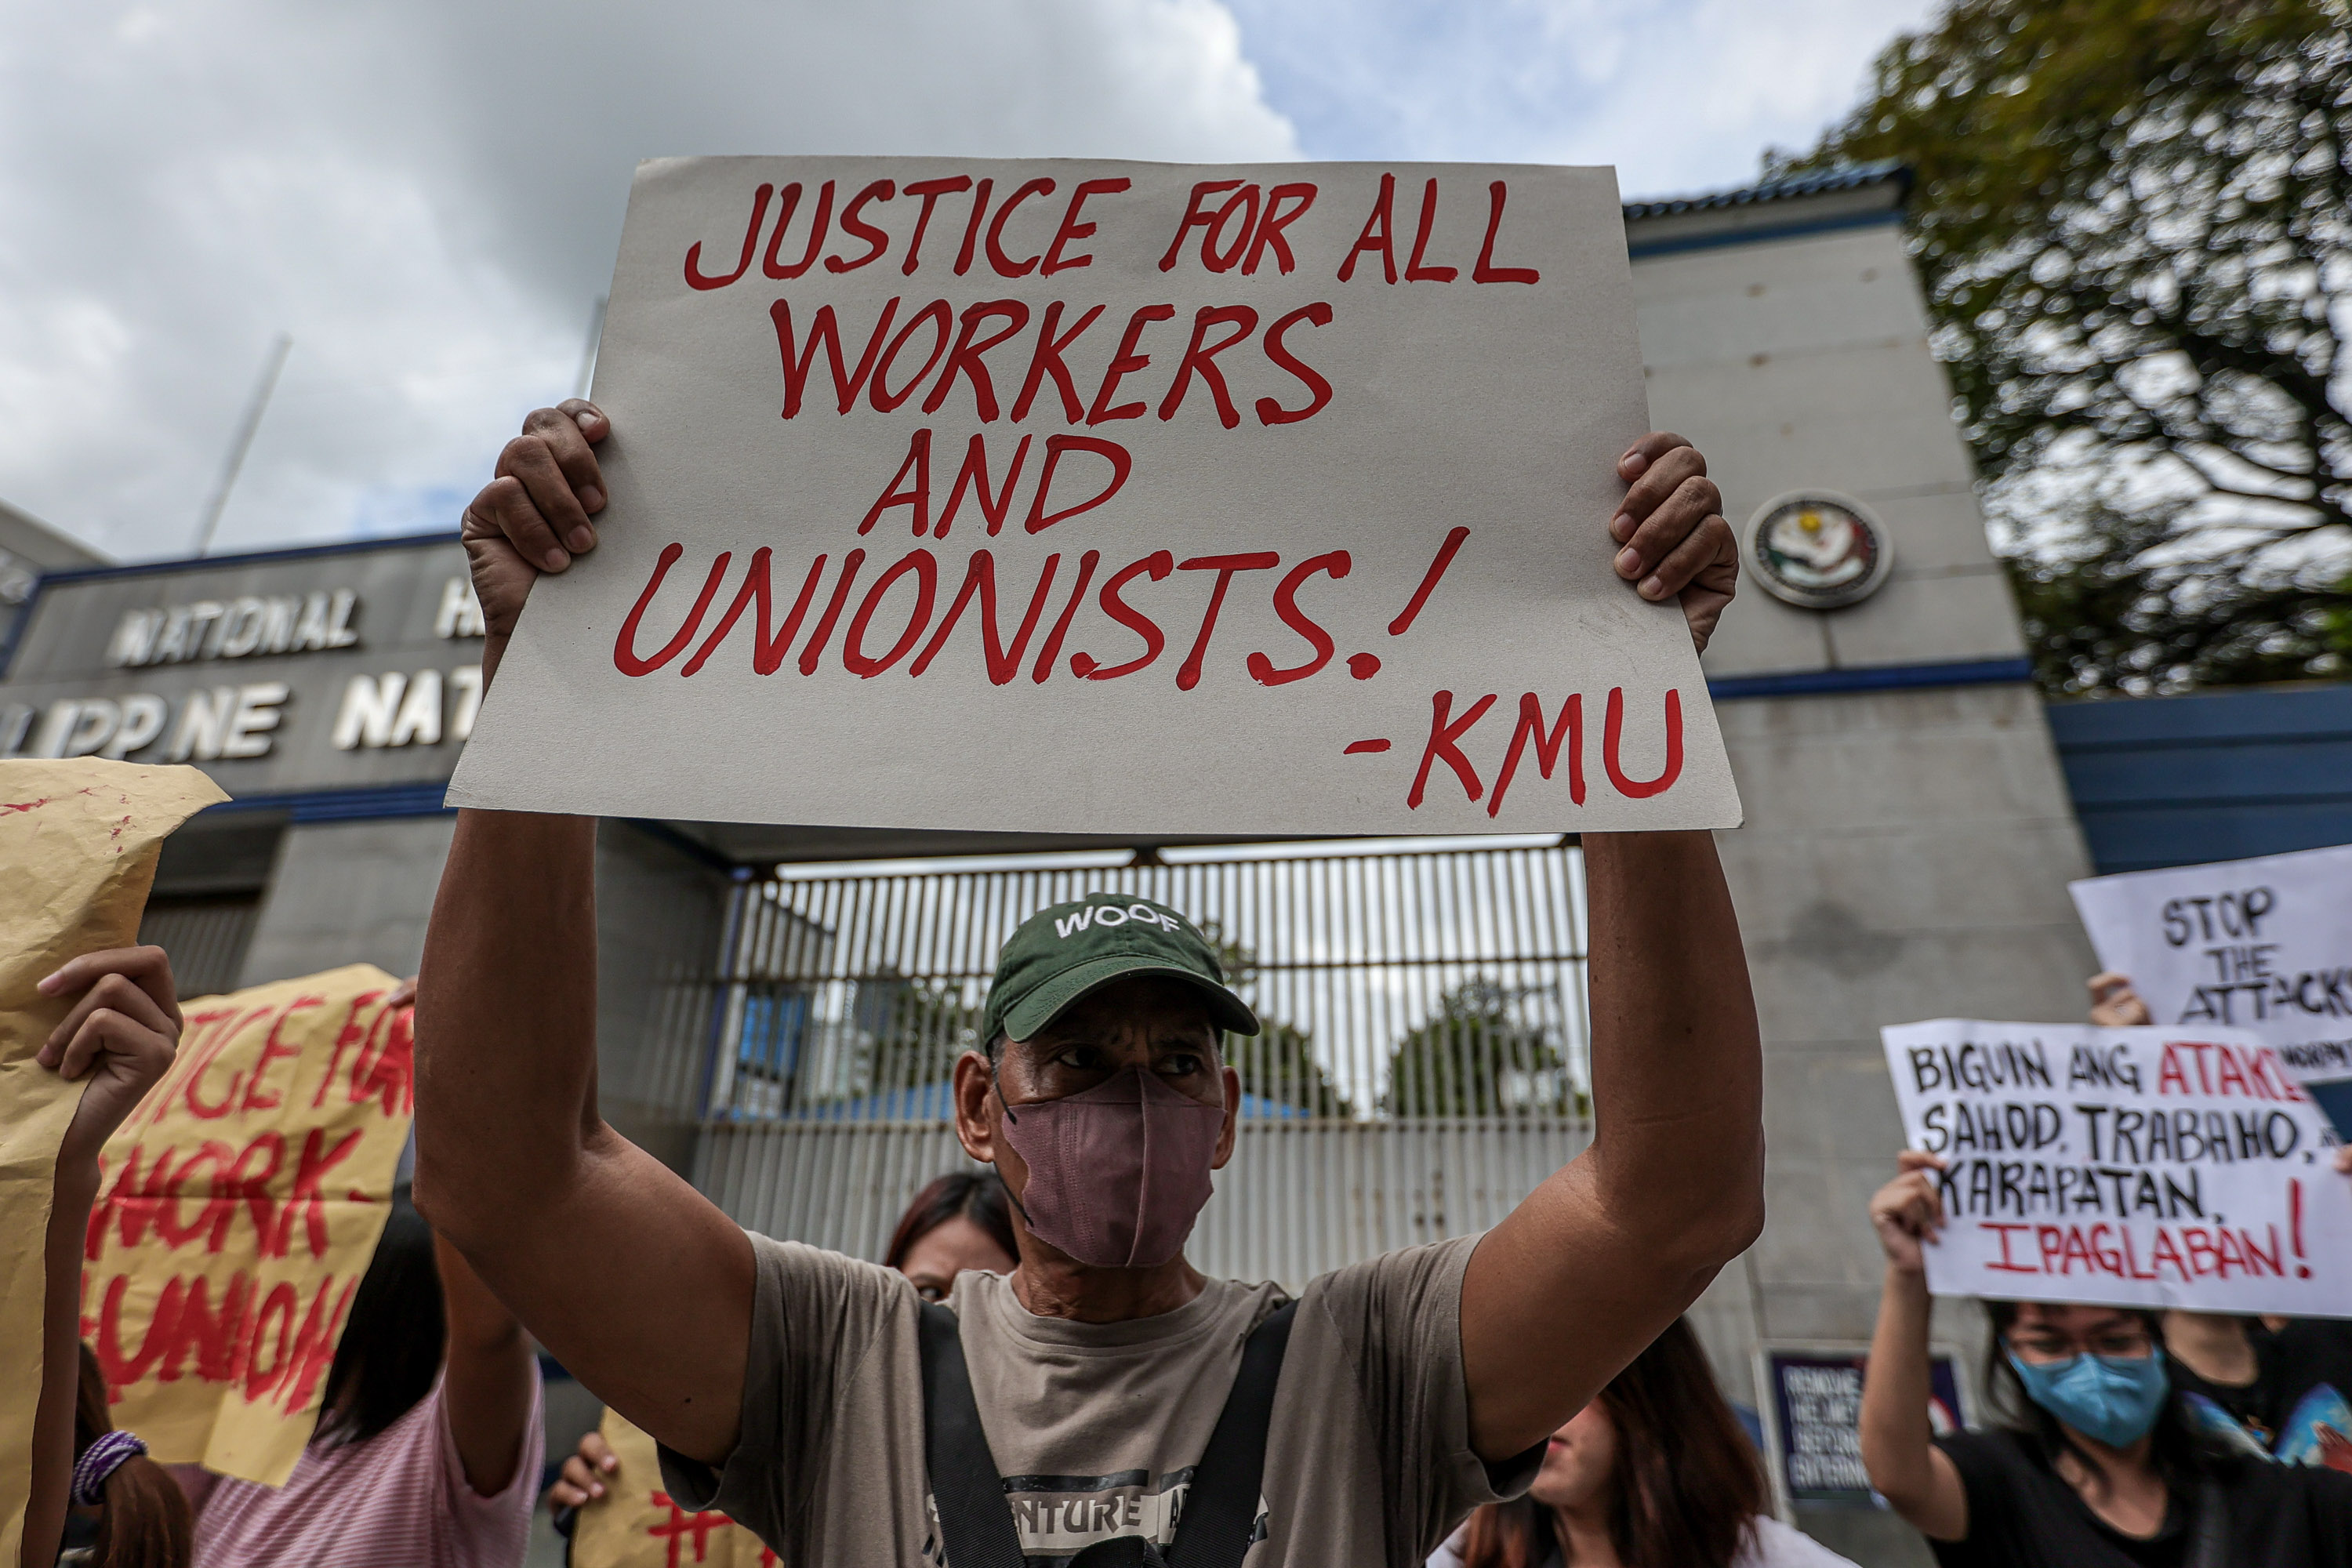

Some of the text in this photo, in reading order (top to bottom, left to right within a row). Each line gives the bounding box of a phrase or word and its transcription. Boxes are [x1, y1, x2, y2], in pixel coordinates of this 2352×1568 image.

[686, 173, 1539, 290] JUSTICE FOR ALL
[771, 297, 1332, 429] WORKERS
[858, 430, 1131, 539] AND
[112, 588, 358, 666] NATIONAL
[615, 527, 1469, 691] UNIONISTS!
[1054, 904, 1181, 938] WOOF
[2162, 886, 2277, 946] STOP
[2179, 967, 2352, 1025] ATTACK
[2204, 942, 2283, 982] THE
[1907, 1040, 2053, 1093] BIGUIN
[2067, 1043, 2143, 1094] ANG
[1978, 1178, 2314, 1283] IPAGLABAN!
